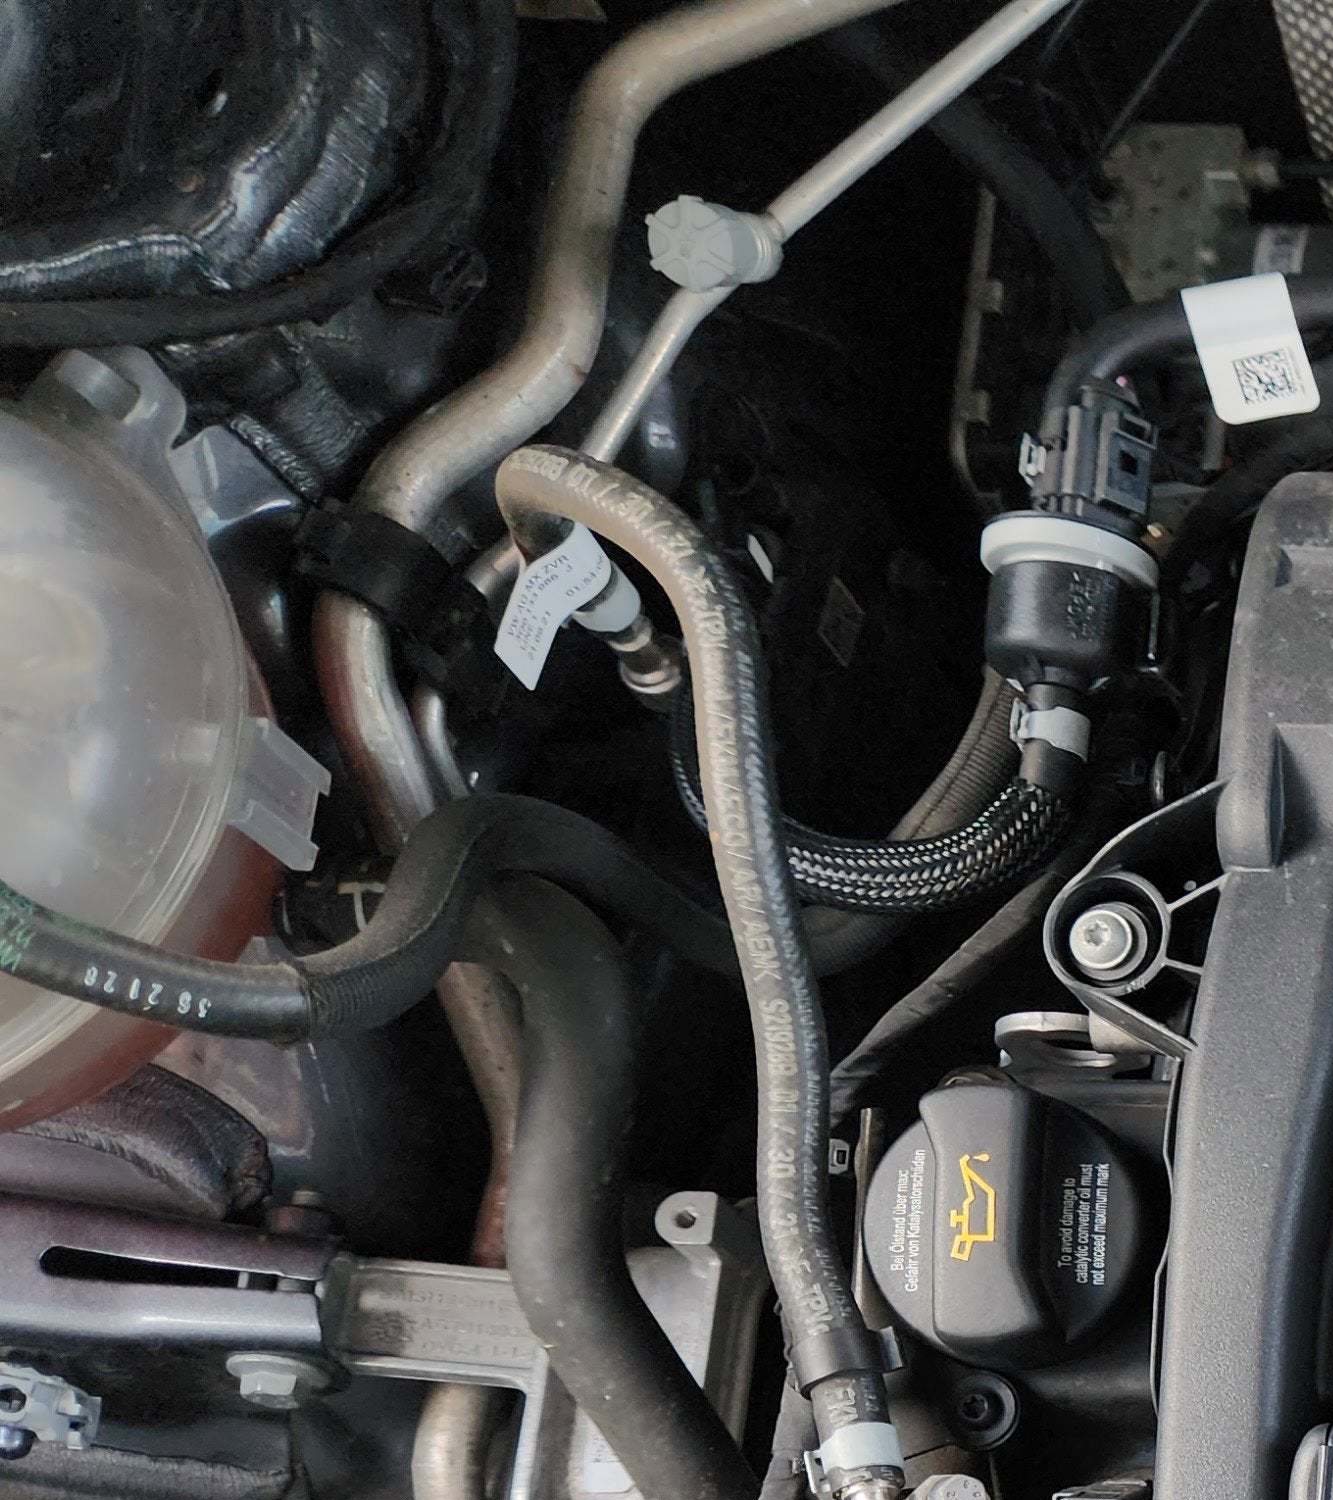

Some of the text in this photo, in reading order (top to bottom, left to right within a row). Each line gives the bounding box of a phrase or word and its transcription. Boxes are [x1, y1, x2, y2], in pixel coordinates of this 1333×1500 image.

[768, 1146, 797, 1179] 30
[892, 1193, 908, 1216] über
[1060, 1187, 1079, 1226] damage
[888, 1217, 907, 1254] Ölstand
[1074, 1163, 1093, 1284] catalytic converter oil must
[1090, 1163, 1110, 1286] not exceed maximum mark
[908, 1240, 920, 1259] von
[1058, 1227, 1073, 1254] avoid
[889, 1255, 905, 1271] Bei
[904, 1259, 919, 1292] Gefahr
[1057, 1254, 1073, 1268] To
